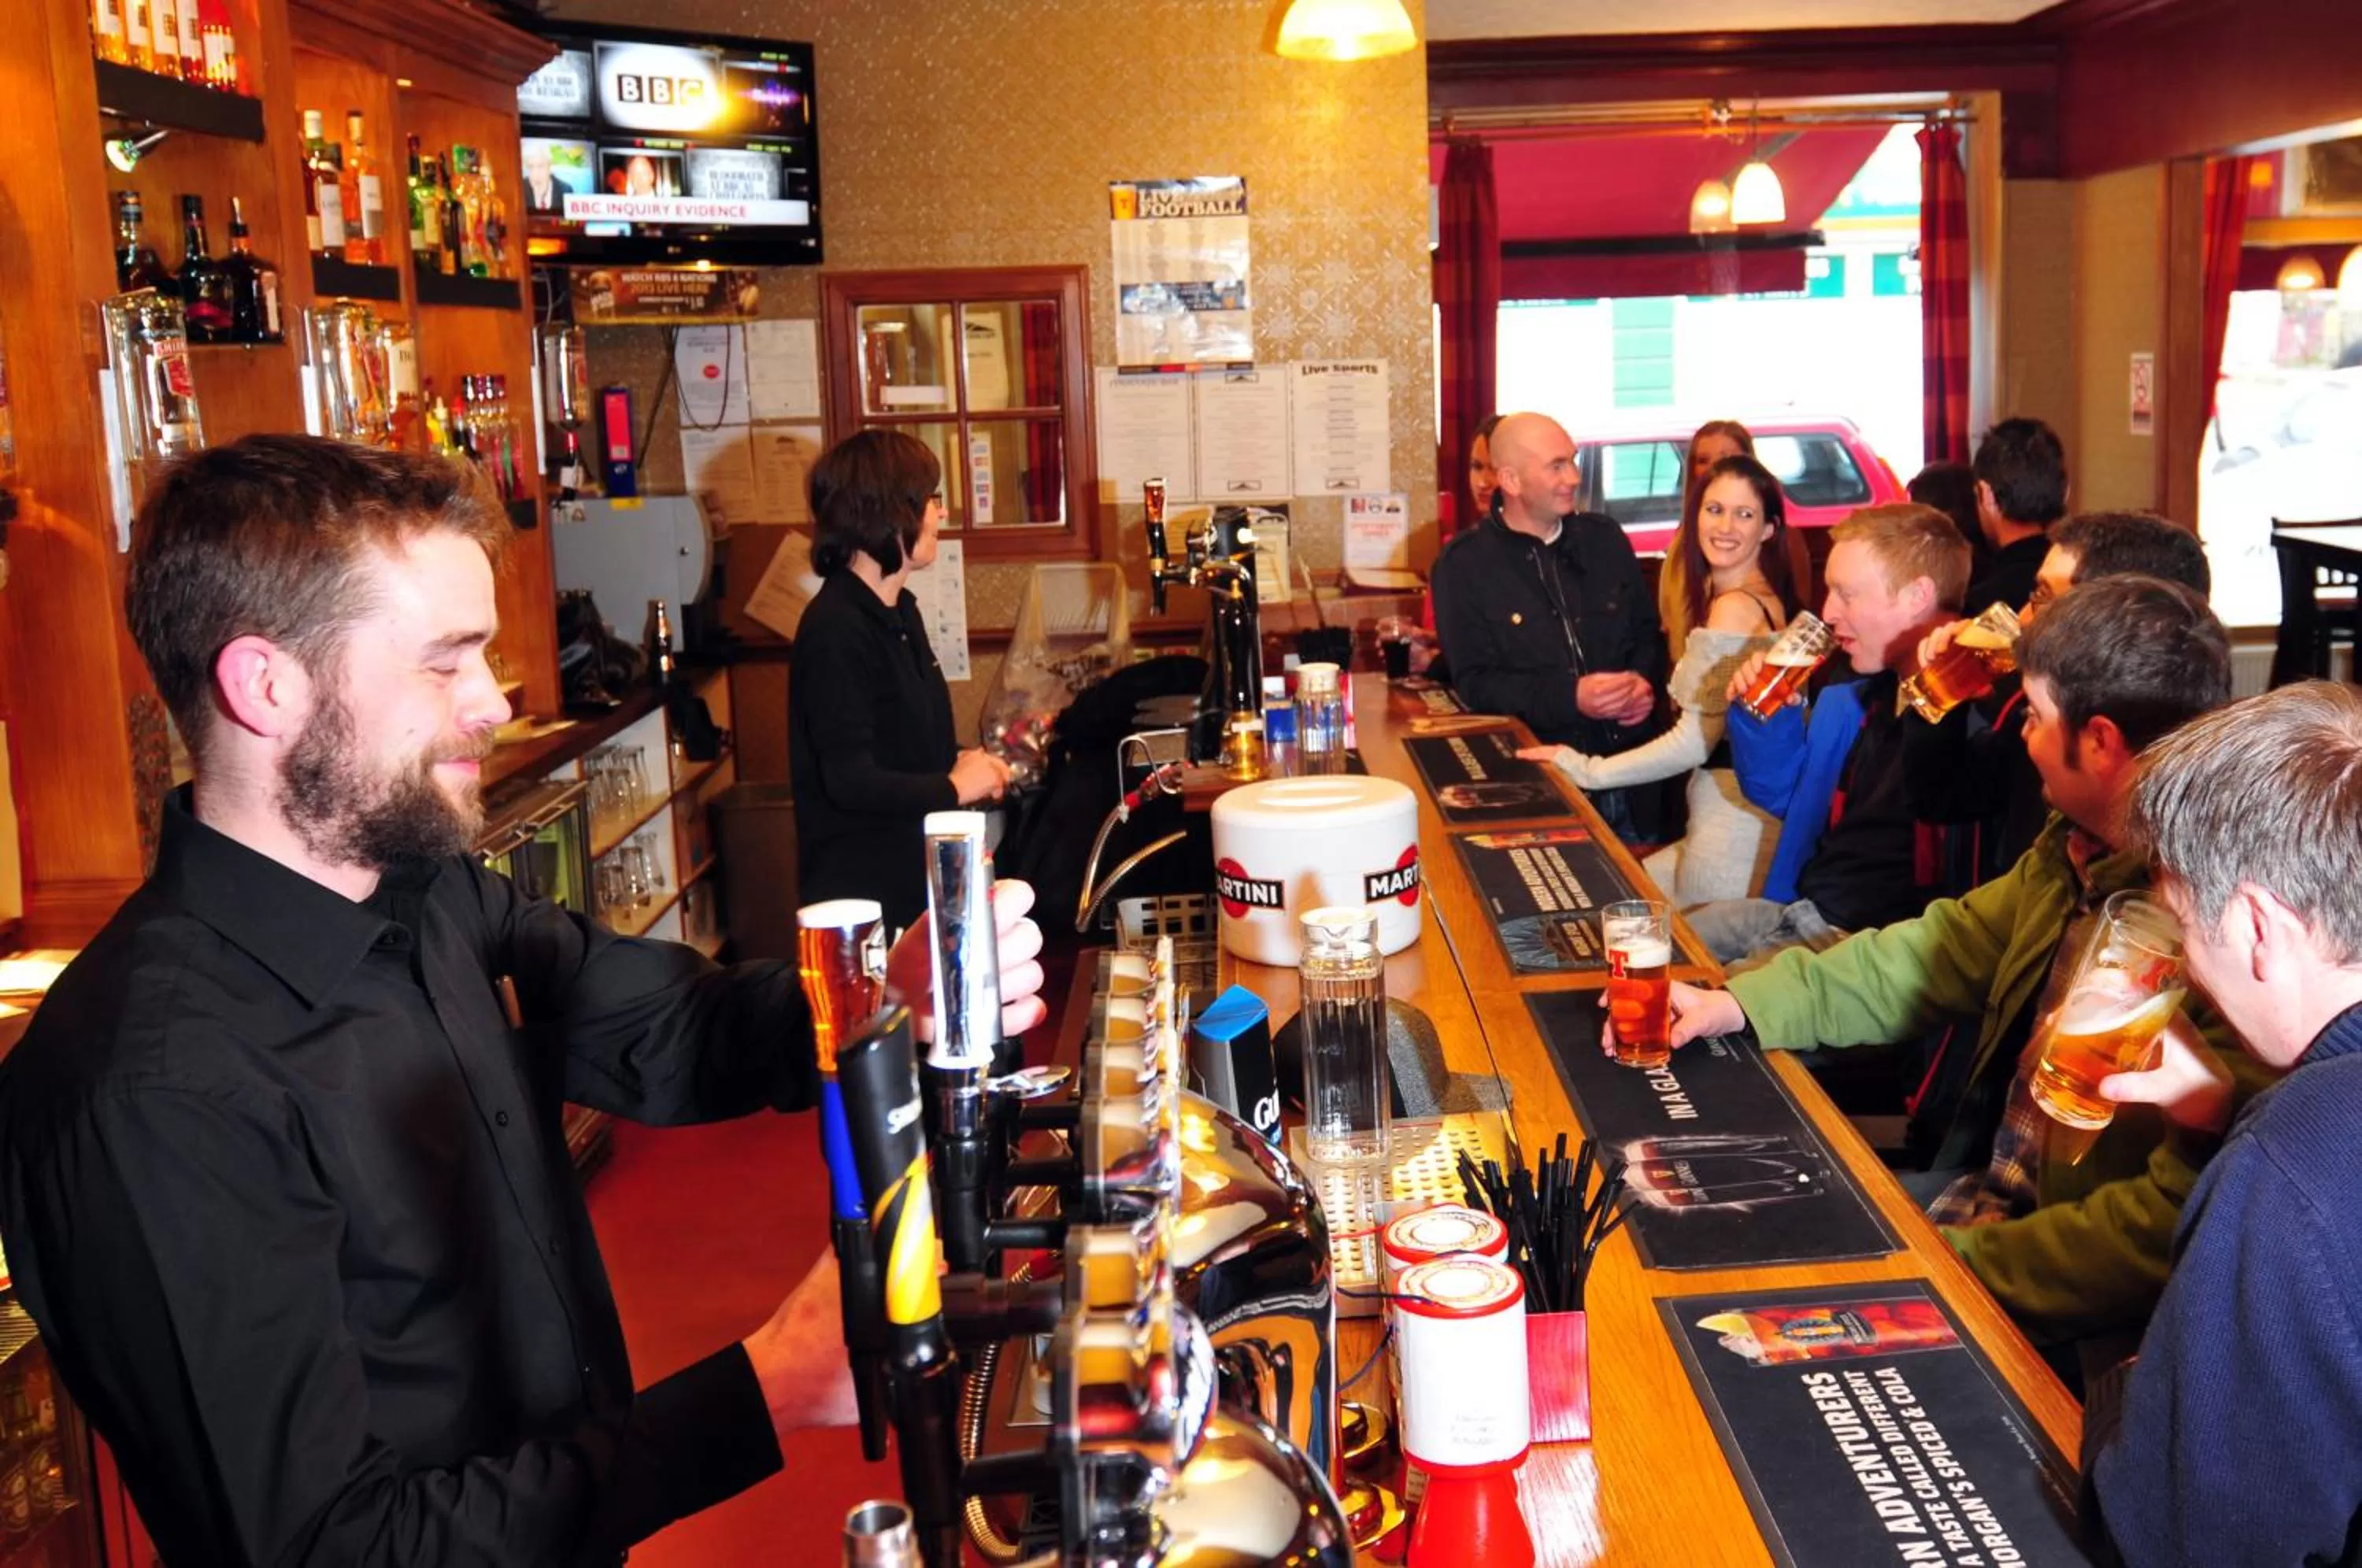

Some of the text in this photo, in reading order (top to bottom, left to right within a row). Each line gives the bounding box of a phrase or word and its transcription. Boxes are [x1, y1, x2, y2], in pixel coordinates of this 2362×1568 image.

[617, 74, 703, 105] BBC
[570, 202, 746, 218] BBC INQUIRY EVIDENCE
[1139, 200, 1243, 217] FOOTBALL
[657, 283, 680, 294] LIVE
[1301, 365, 1329, 376] Live
[1660, 1092, 1689, 1102] A
[1664, 1104, 1699, 1119] IN
[1874, 1366, 1916, 1404] COLA
[1842, 1370, 1906, 1444] DIFFERENT
[1900, 1406, 1926, 1418] &
[1801, 1370, 1927, 1534] ADVENTURERS
[1889, 1444, 1941, 1500] CALLED
[1923, 1501, 1974, 1552] TASTE
[1957, 1553, 1985, 1566] A
